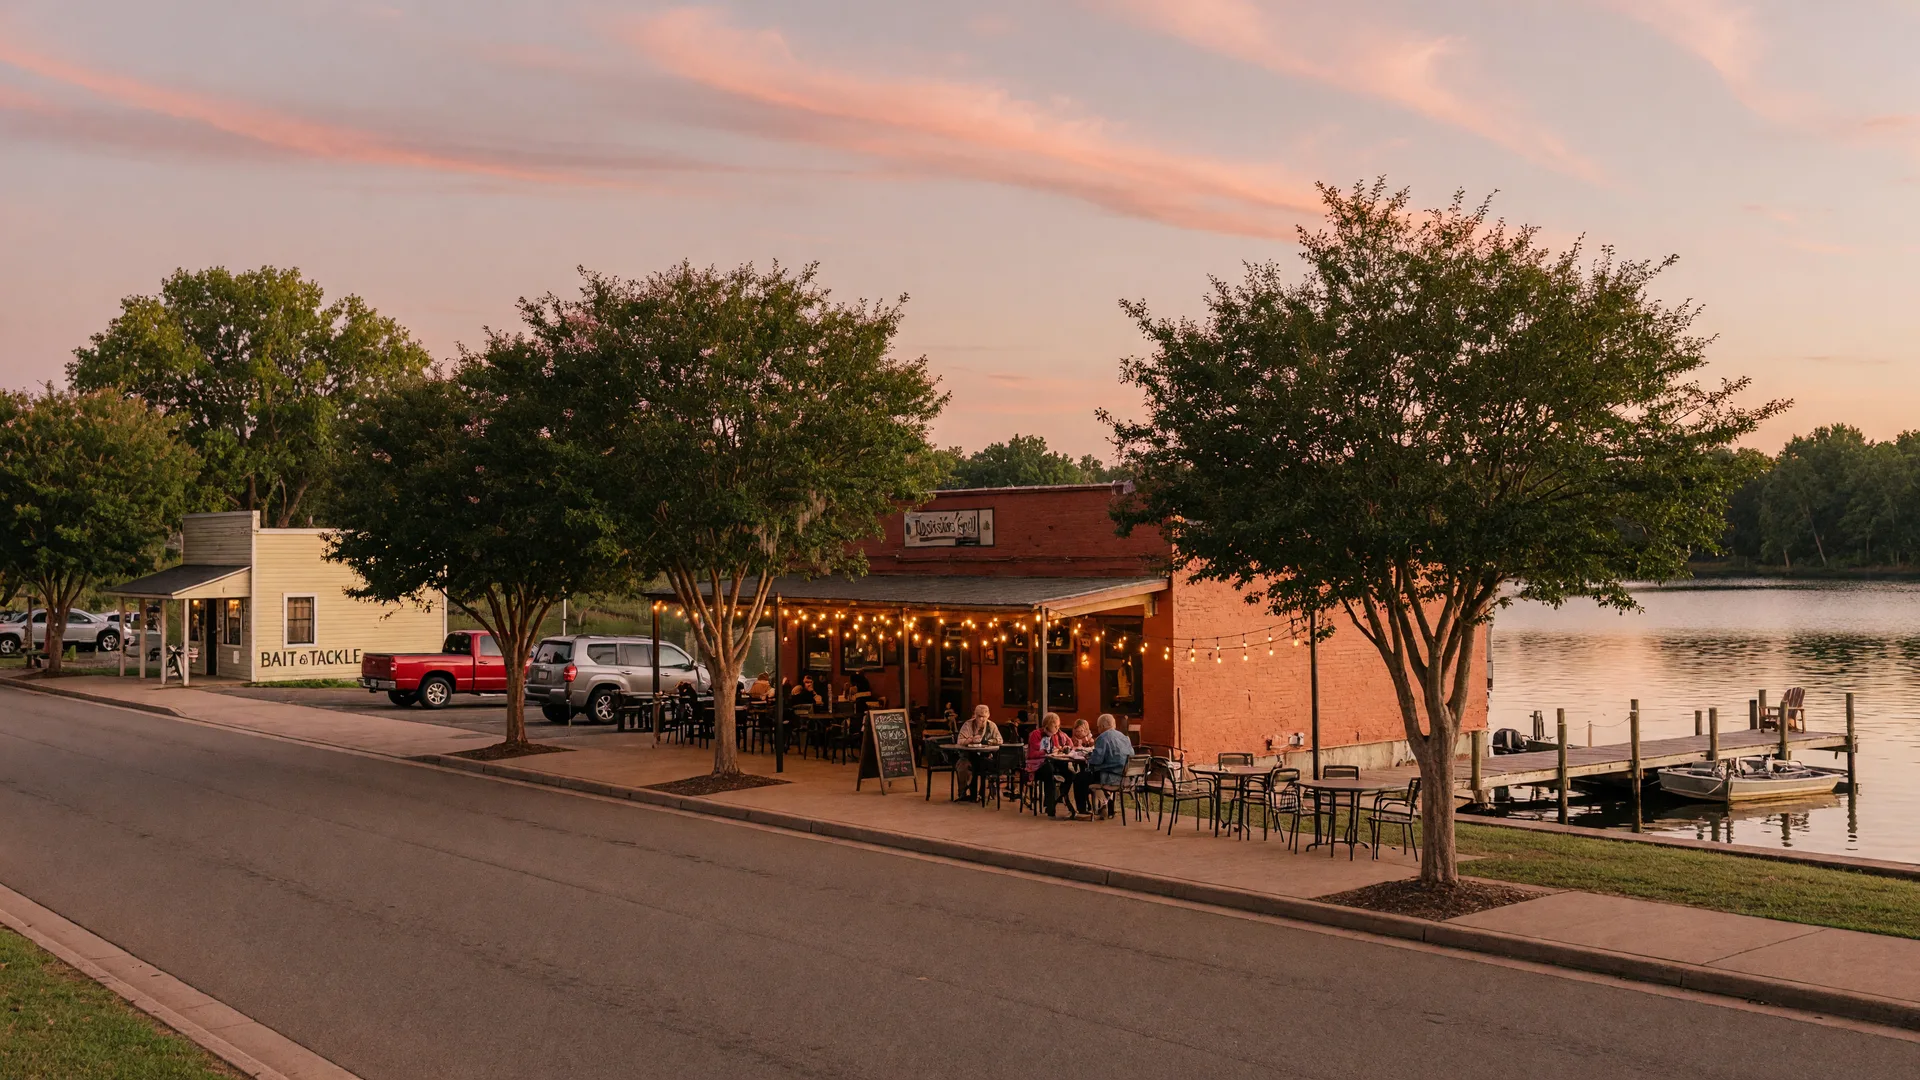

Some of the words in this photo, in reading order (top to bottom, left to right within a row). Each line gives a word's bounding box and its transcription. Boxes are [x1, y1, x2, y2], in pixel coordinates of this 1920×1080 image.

[261, 651, 297, 668] BAIT
[299, 654, 308, 665] &
[309, 649, 361, 666] TACKLE
